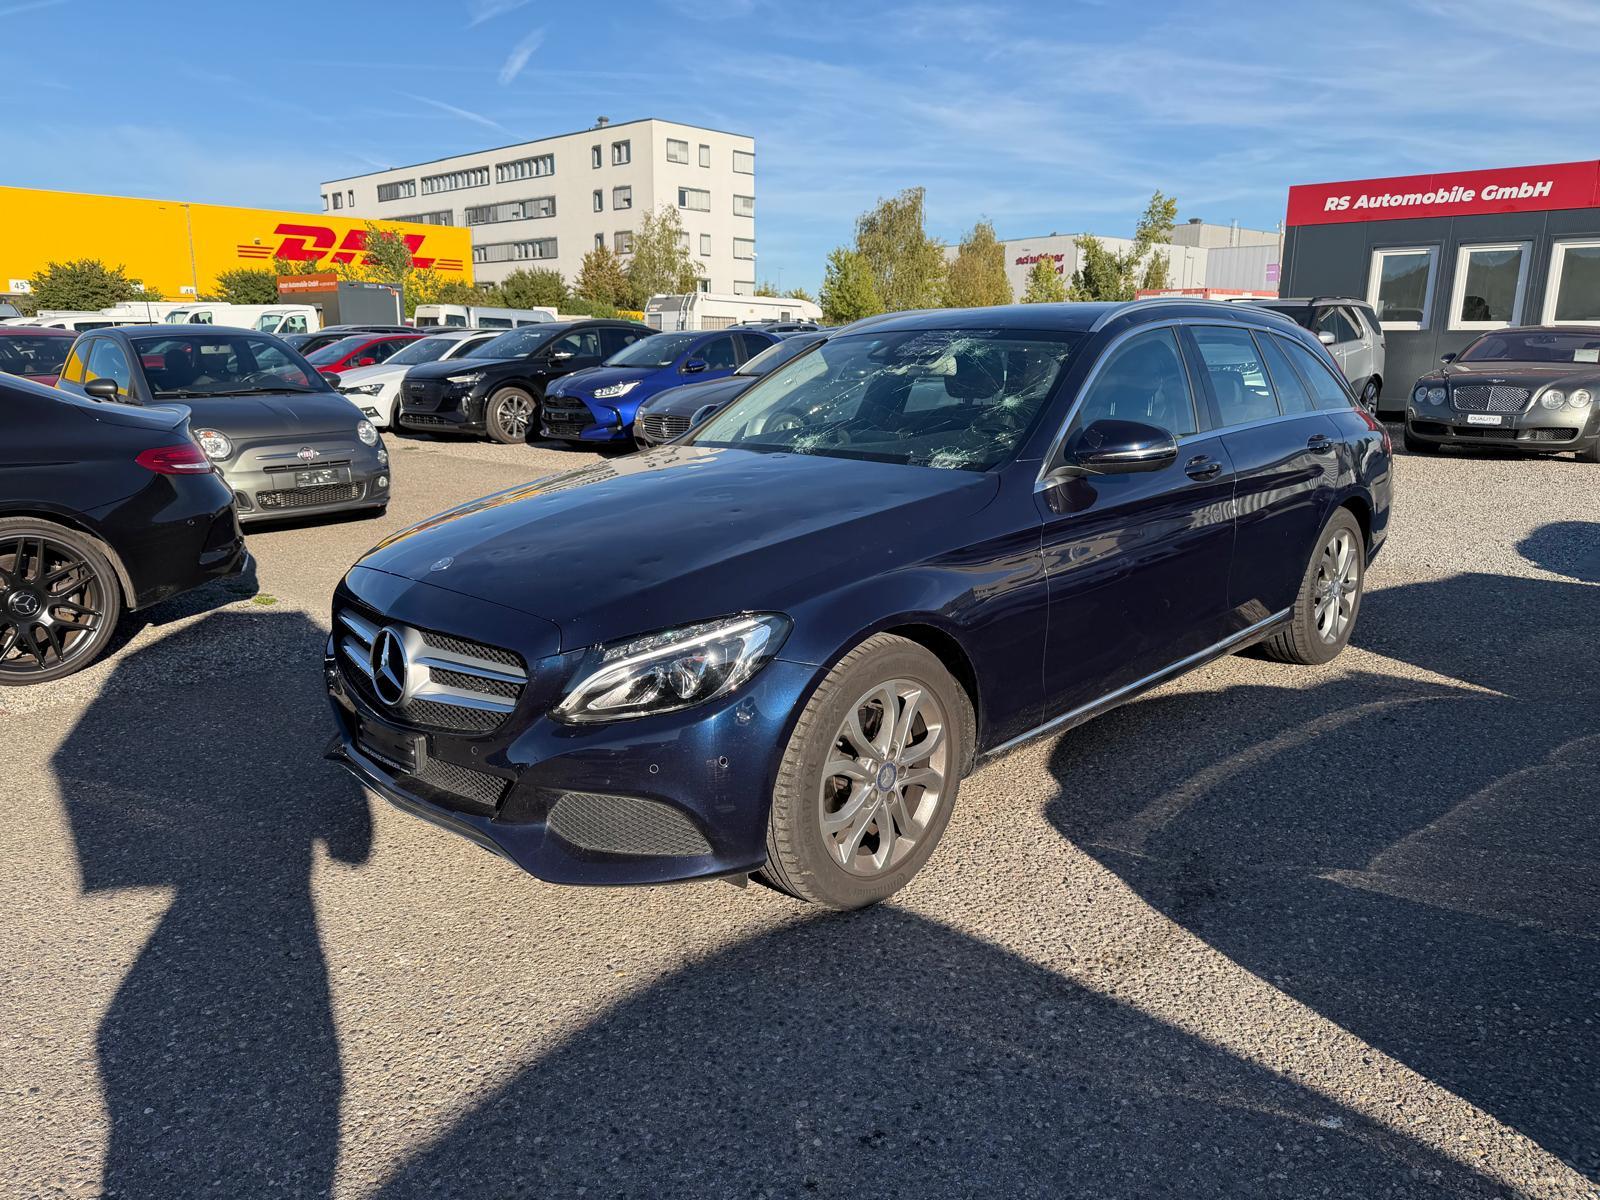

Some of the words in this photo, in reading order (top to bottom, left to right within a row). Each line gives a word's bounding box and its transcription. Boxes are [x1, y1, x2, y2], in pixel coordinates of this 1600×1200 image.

[1324, 196, 1351, 211] RS
[1352, 186, 1475, 210] Automobile
[1480, 181, 1553, 201] GmbH
[273, 223, 436, 269] DHL
[14, 281, 25, 290] 45
